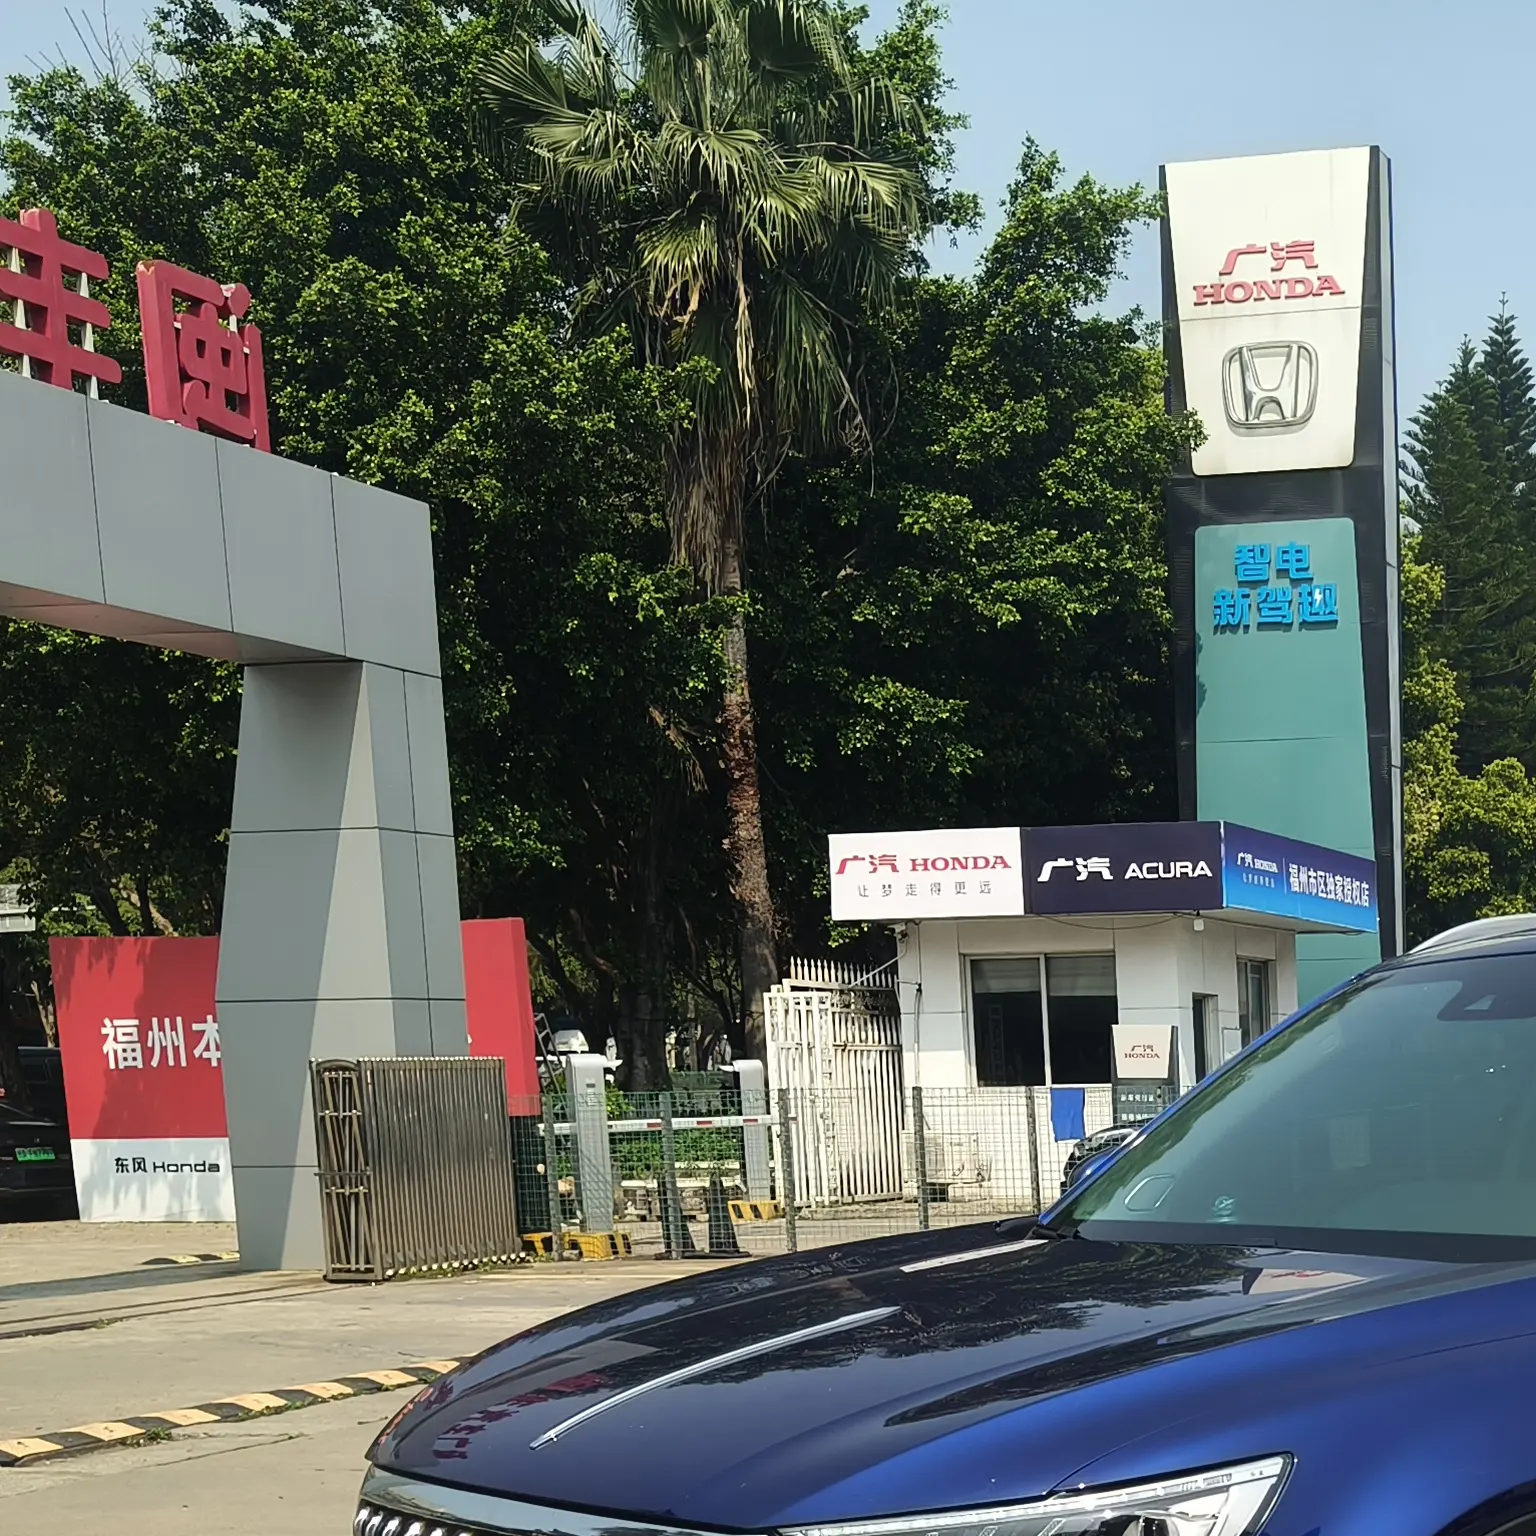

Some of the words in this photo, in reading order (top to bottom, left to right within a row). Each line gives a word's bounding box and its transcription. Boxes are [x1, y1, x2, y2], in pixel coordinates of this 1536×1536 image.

[1219, 240, 1319, 276] 广汽
[1193, 275, 1346, 306] HONDA
[1234, 541, 1314, 582] 智电
[835, 854, 899, 875] 广汽
[909, 855, 1012, 872] HONDA
[1037, 857, 1114, 882] 广汽
[1124, 860, 1213, 880] ACURA
[1254, 858, 1279, 873] HONDA
[857, 880, 992, 898] 让梦走得更远
[1288, 862, 1370, 908] 福州市区独家授权店
[114, 1157, 148, 1174] 东风
[152, 1160, 220, 1173] Honda
